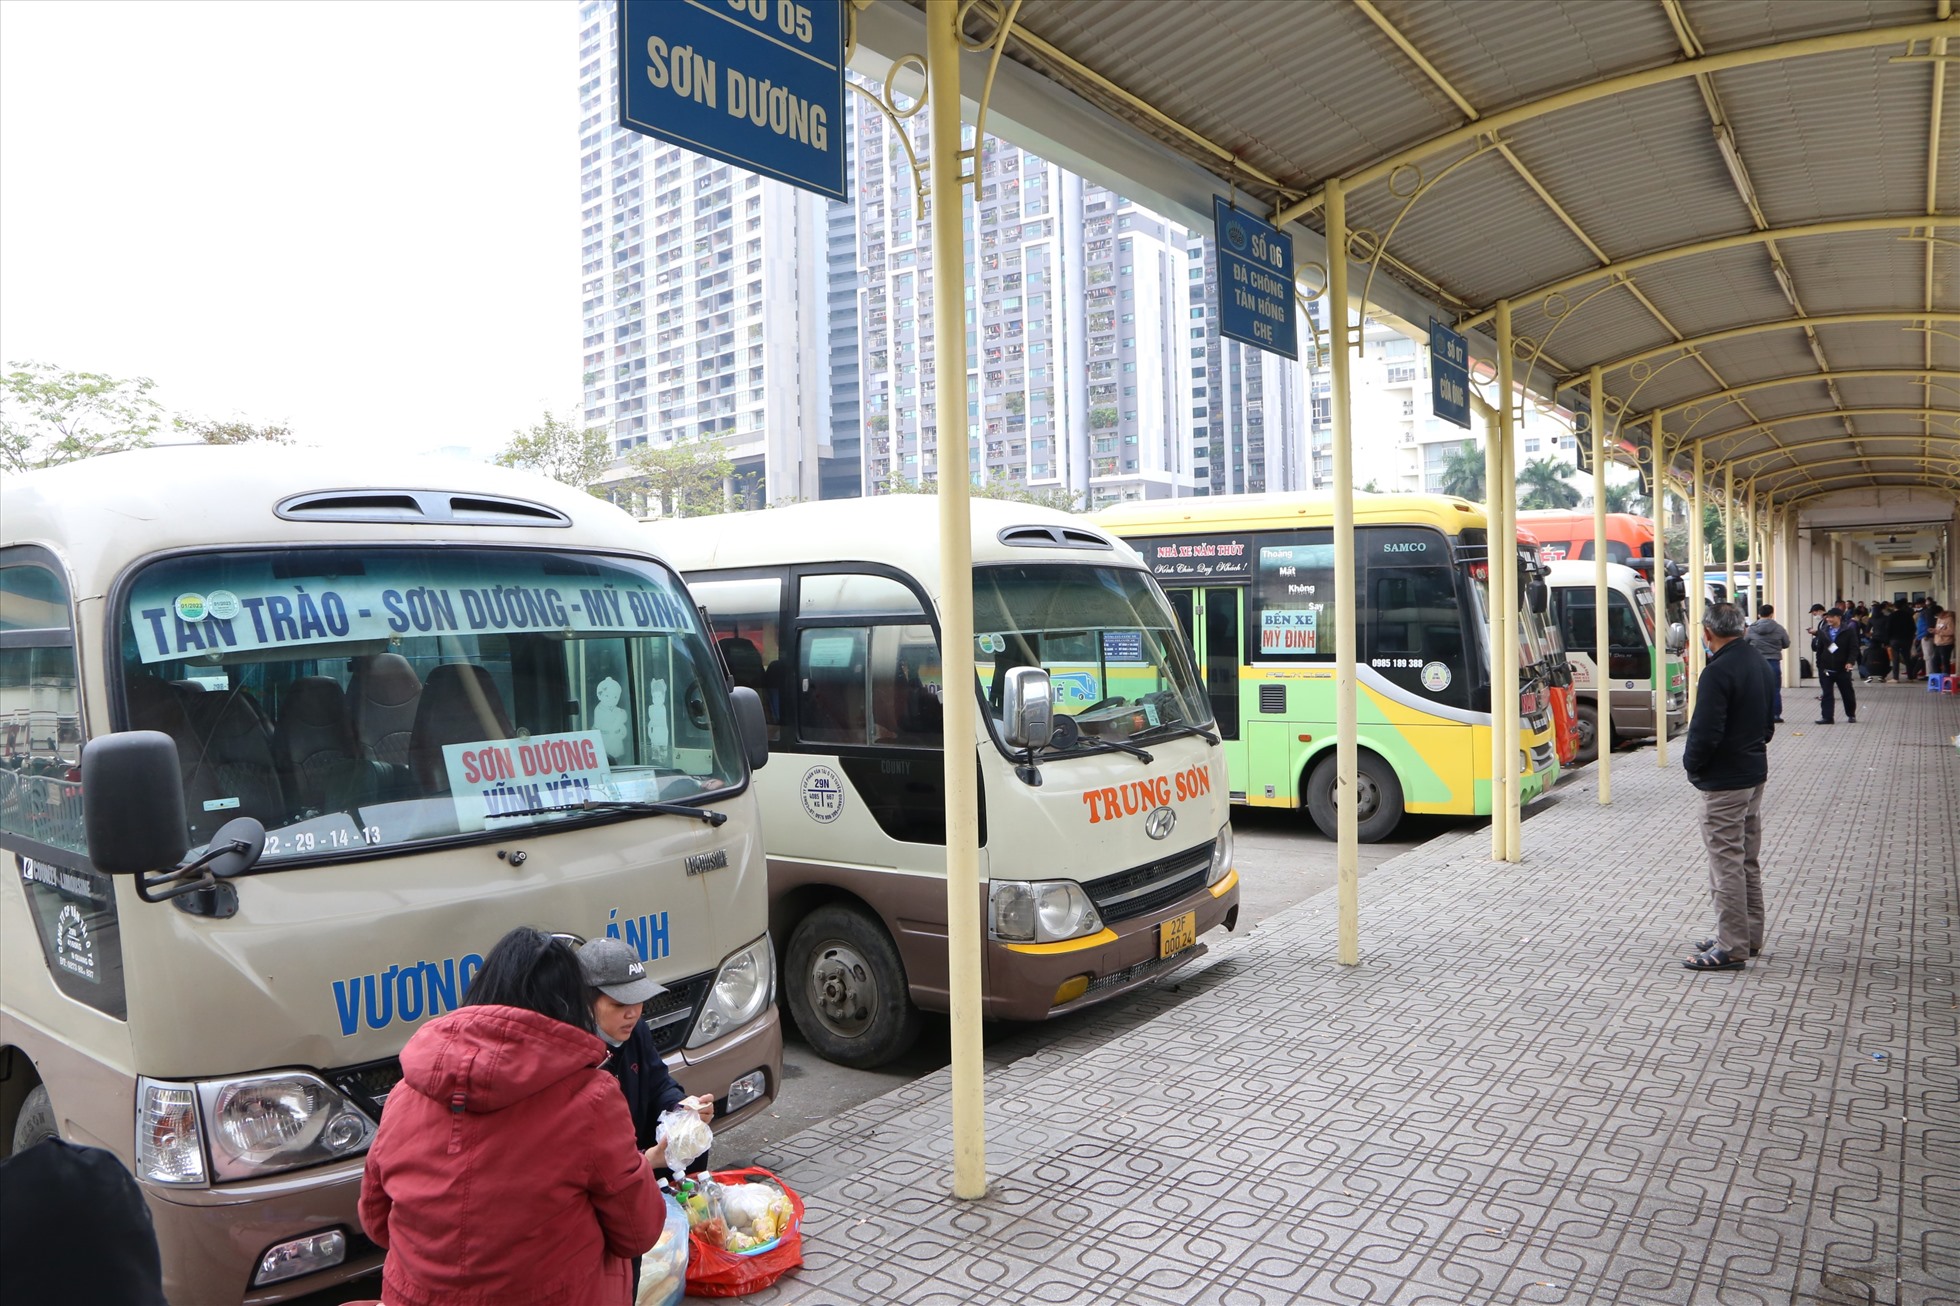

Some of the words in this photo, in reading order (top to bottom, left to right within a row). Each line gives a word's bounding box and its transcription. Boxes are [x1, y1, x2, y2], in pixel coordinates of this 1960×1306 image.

[647, 35, 716, 109] SƠN
[727, 68, 827, 152] DƯƠNG
[1251, 232, 1267, 261] SỐ
[1269, 244, 1283, 269] 06
[1233, 263, 1248, 284] ĐÁ
[1250, 272, 1284, 300] CHÔNG
[1234, 287, 1255, 311] TẢN
[1179, 546, 1192, 557] XE
[1193, 542, 1215, 557] NĂM
[1262, 549, 1293, 560] Thoáng
[1383, 542, 1427, 553] SAMCO
[1279, 566, 1296, 575] Mát
[1288, 583, 1315, 594] Không
[242, 586, 349, 643] TRÀO
[381, 586, 458, 633] SƠN
[460, 585, 571, 629] DƯƠNG
[581, 584, 624, 627] MỸ
[625, 585, 689, 629] ĐÌNH
[1308, 602, 1324, 614] Say
[1265, 611, 1291, 625] BẾN
[1295, 615, 1313, 625] XE
[1263, 626, 1280, 648] MỸ
[1285, 626, 1315, 649] ĐÌNH
[1372, 658, 1391, 668] 0985
[1392, 658, 1407, 668] 189
[1408, 658, 1423, 668] 388
[462, 746, 517, 784] SƠN
[518, 738, 598, 776] DƯƠNG
[881, 760, 911, 775] COUNTY
[815, 779, 830, 788] 29N
[482, 782, 543, 816] VĨNH
[545, 773, 591, 811] YÊN
[1083, 780, 1171, 824] TRUNG
[1176, 765, 1211, 801] SƠN
[295, 832, 315, 851] 29
[330, 829, 348, 847] 14
[363, 826, 380, 844] 13
[1171, 916, 1185, 935] 22F
